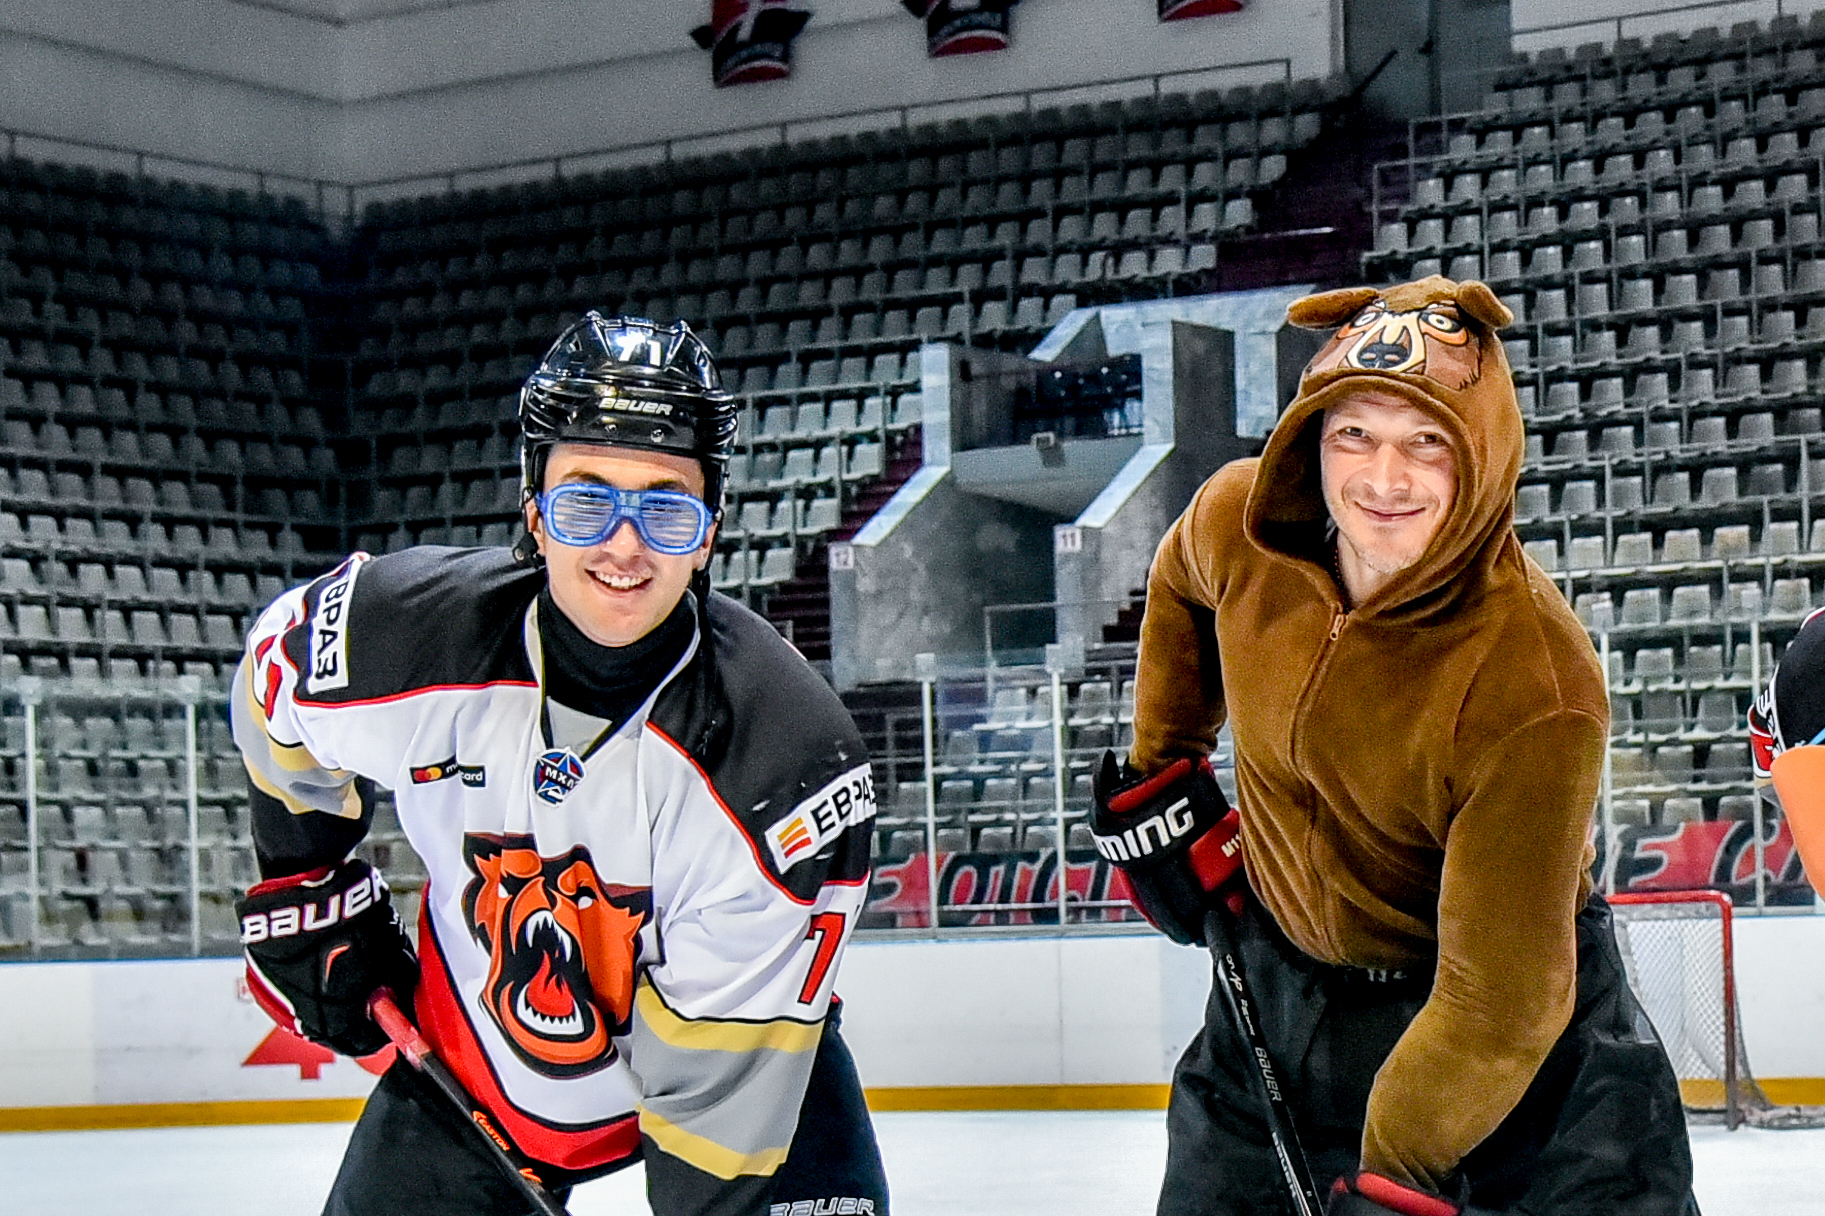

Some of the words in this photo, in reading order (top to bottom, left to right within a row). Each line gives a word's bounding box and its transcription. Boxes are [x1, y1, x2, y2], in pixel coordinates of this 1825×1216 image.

[614, 330, 662, 367] 71
[598, 396, 674, 417] BAUER
[314, 583, 350, 680] ВРАЗ
[796, 911, 846, 1008] 7
